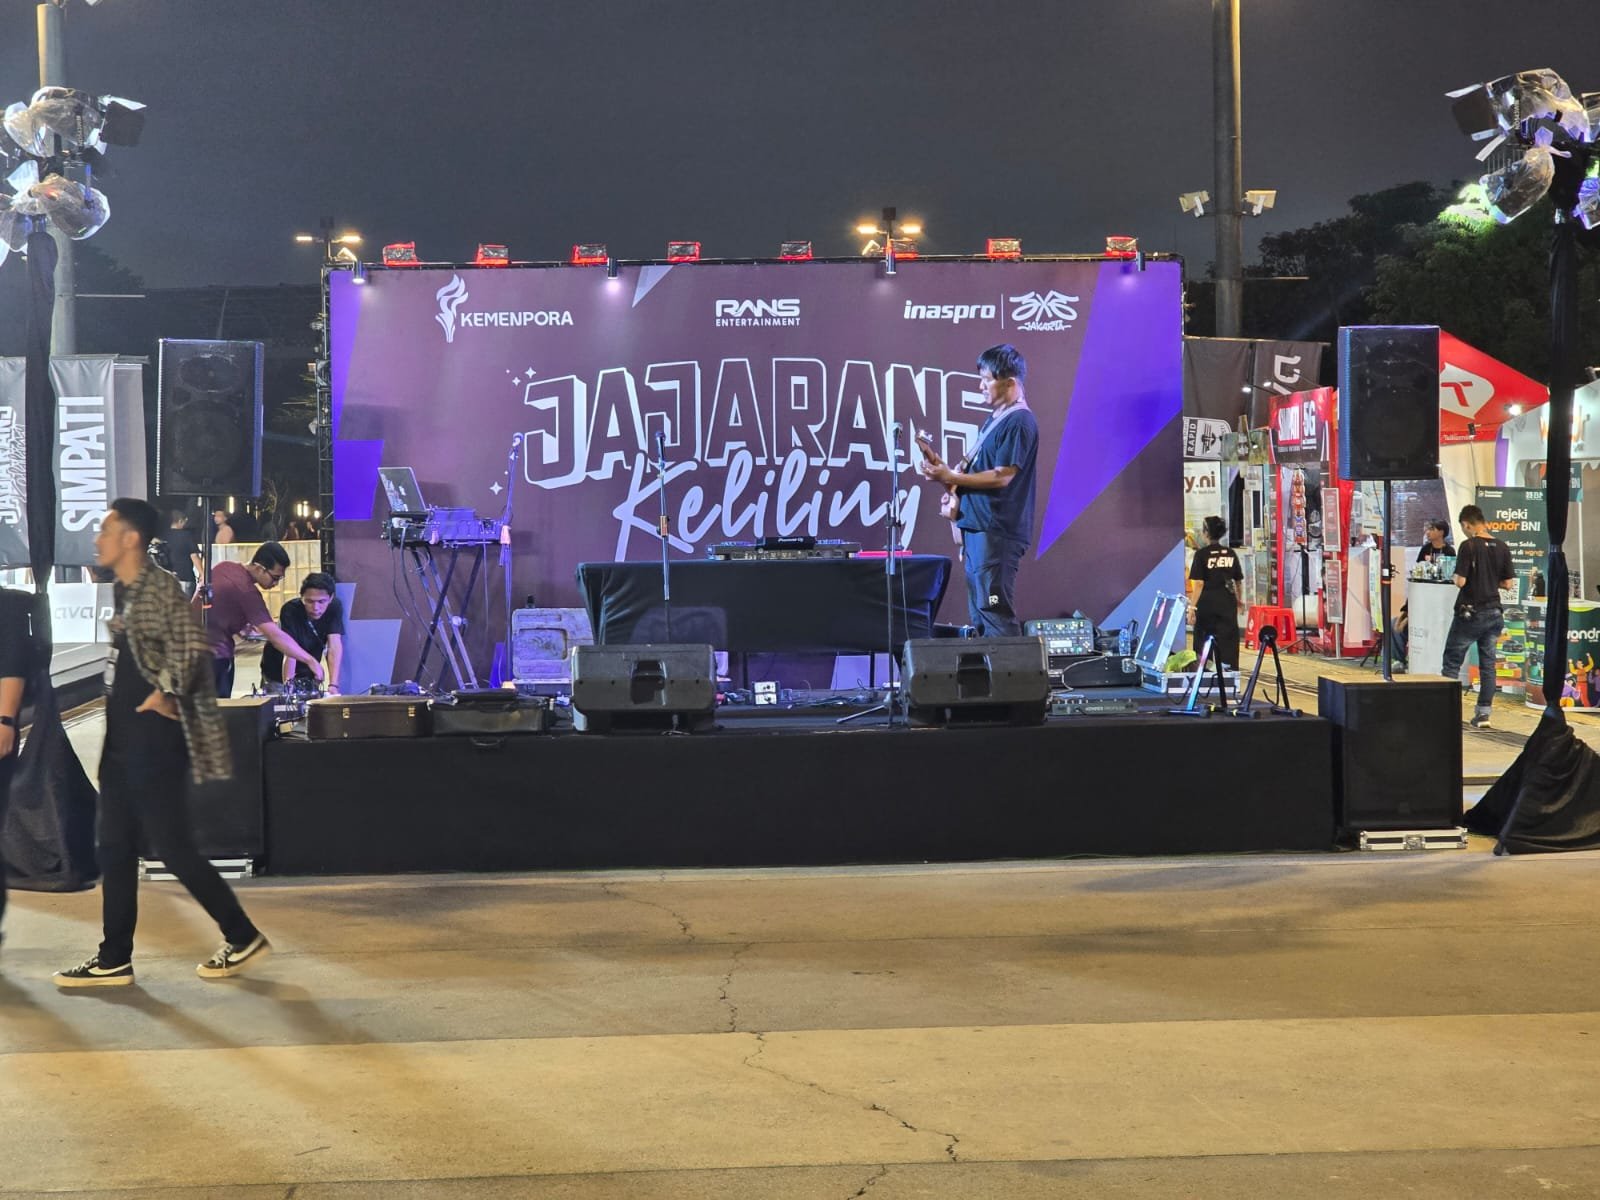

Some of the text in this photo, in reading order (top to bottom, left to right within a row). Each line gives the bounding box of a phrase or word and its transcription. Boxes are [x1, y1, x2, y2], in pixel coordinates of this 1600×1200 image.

[716, 299, 800, 317] RANS
[904, 300, 995, 324] inaspro
[461, 311, 574, 327] KEMENPORA
[716, 318, 800, 327] ENTERTAINMENT
[524, 357, 993, 489] JAJARANS
[1187, 423, 1197, 452] RAPID
[58, 396, 107, 532] SIMPATI
[613, 447, 921, 562] Keliling
[1496, 508, 1528, 521] rejeki
[1521, 521, 1541, 531] BNI
